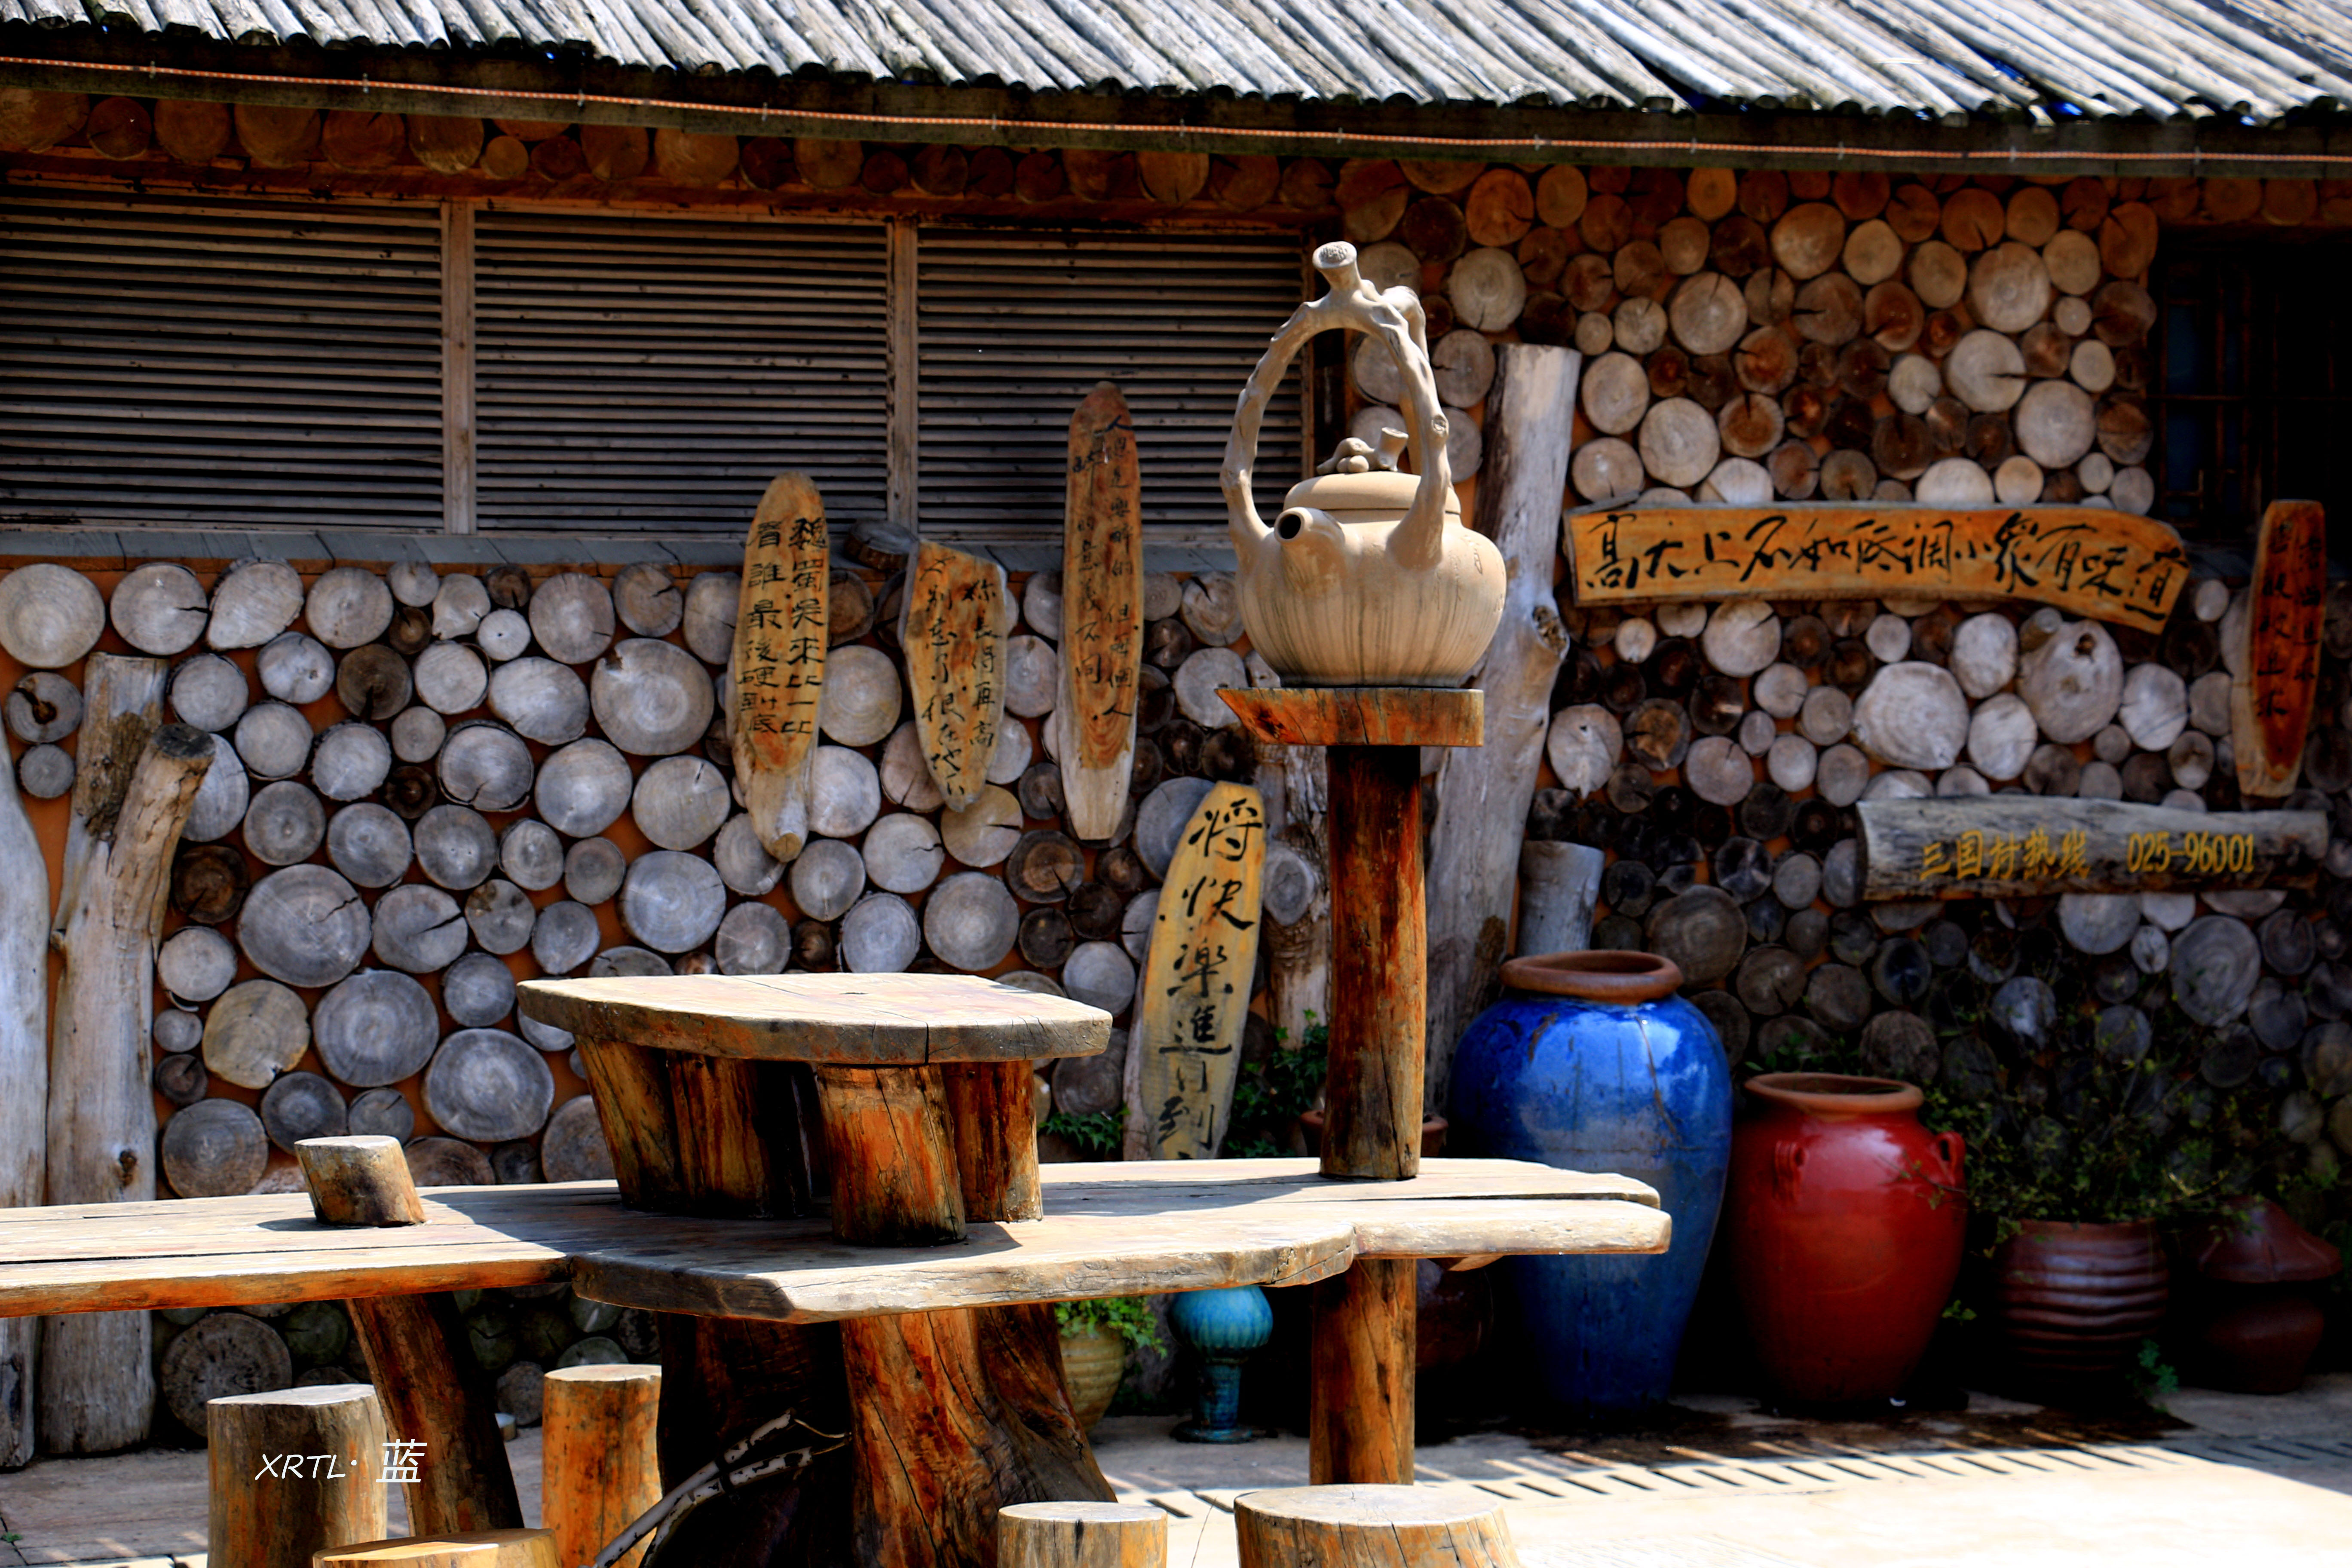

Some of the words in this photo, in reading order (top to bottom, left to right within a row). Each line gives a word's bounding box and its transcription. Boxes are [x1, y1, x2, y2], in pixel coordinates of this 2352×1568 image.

[1919, 827, 2090, 881] 三国村热线
[2126, 831, 2255, 874] 025-96001
